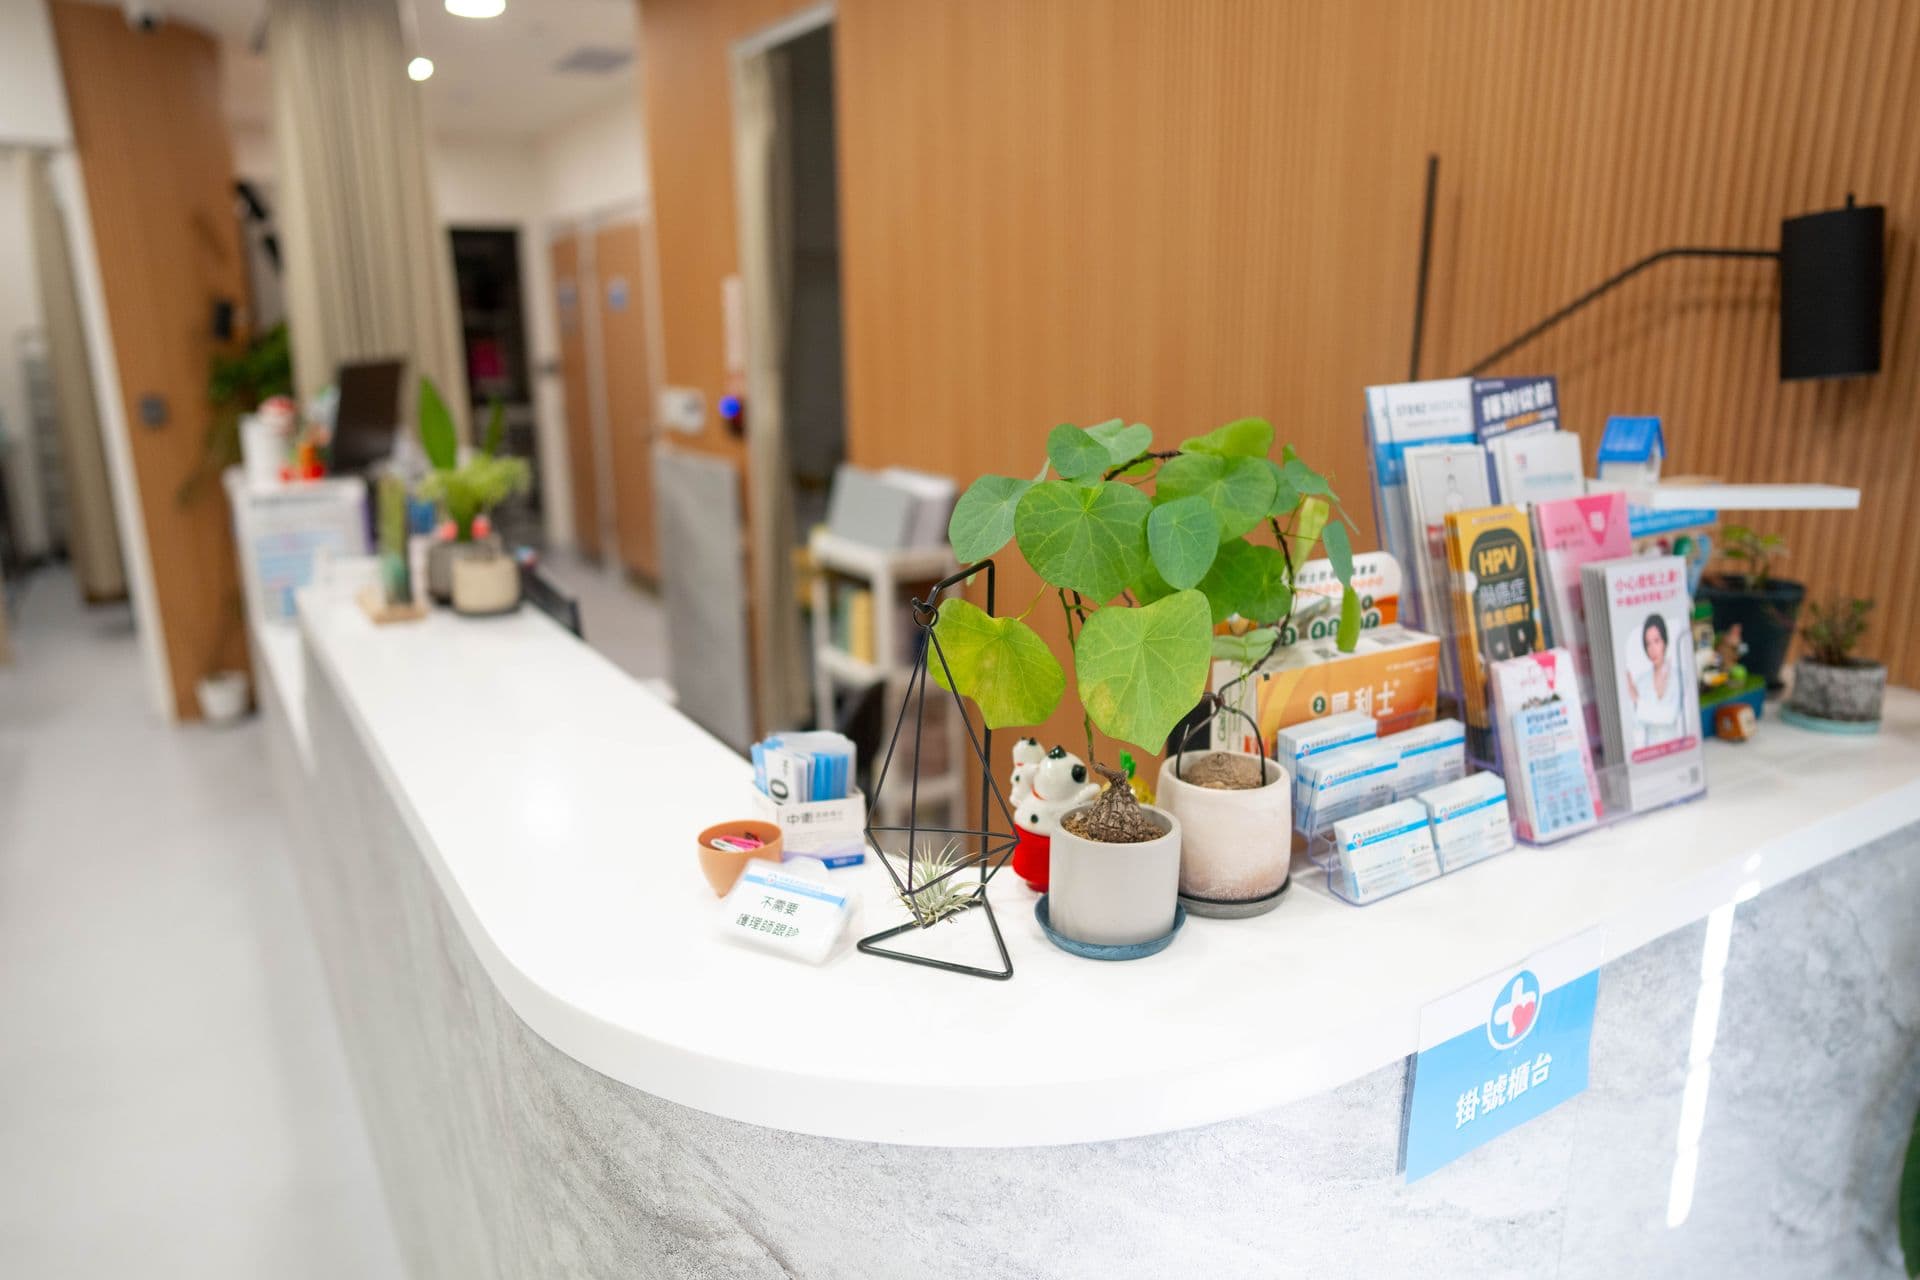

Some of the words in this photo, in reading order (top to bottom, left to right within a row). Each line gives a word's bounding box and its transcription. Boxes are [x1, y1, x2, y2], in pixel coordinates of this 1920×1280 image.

[1478, 544, 1518, 577] HPV
[760, 895, 800, 916] 不需要
[1455, 1052, 1553, 1130] 掛號櫃台
